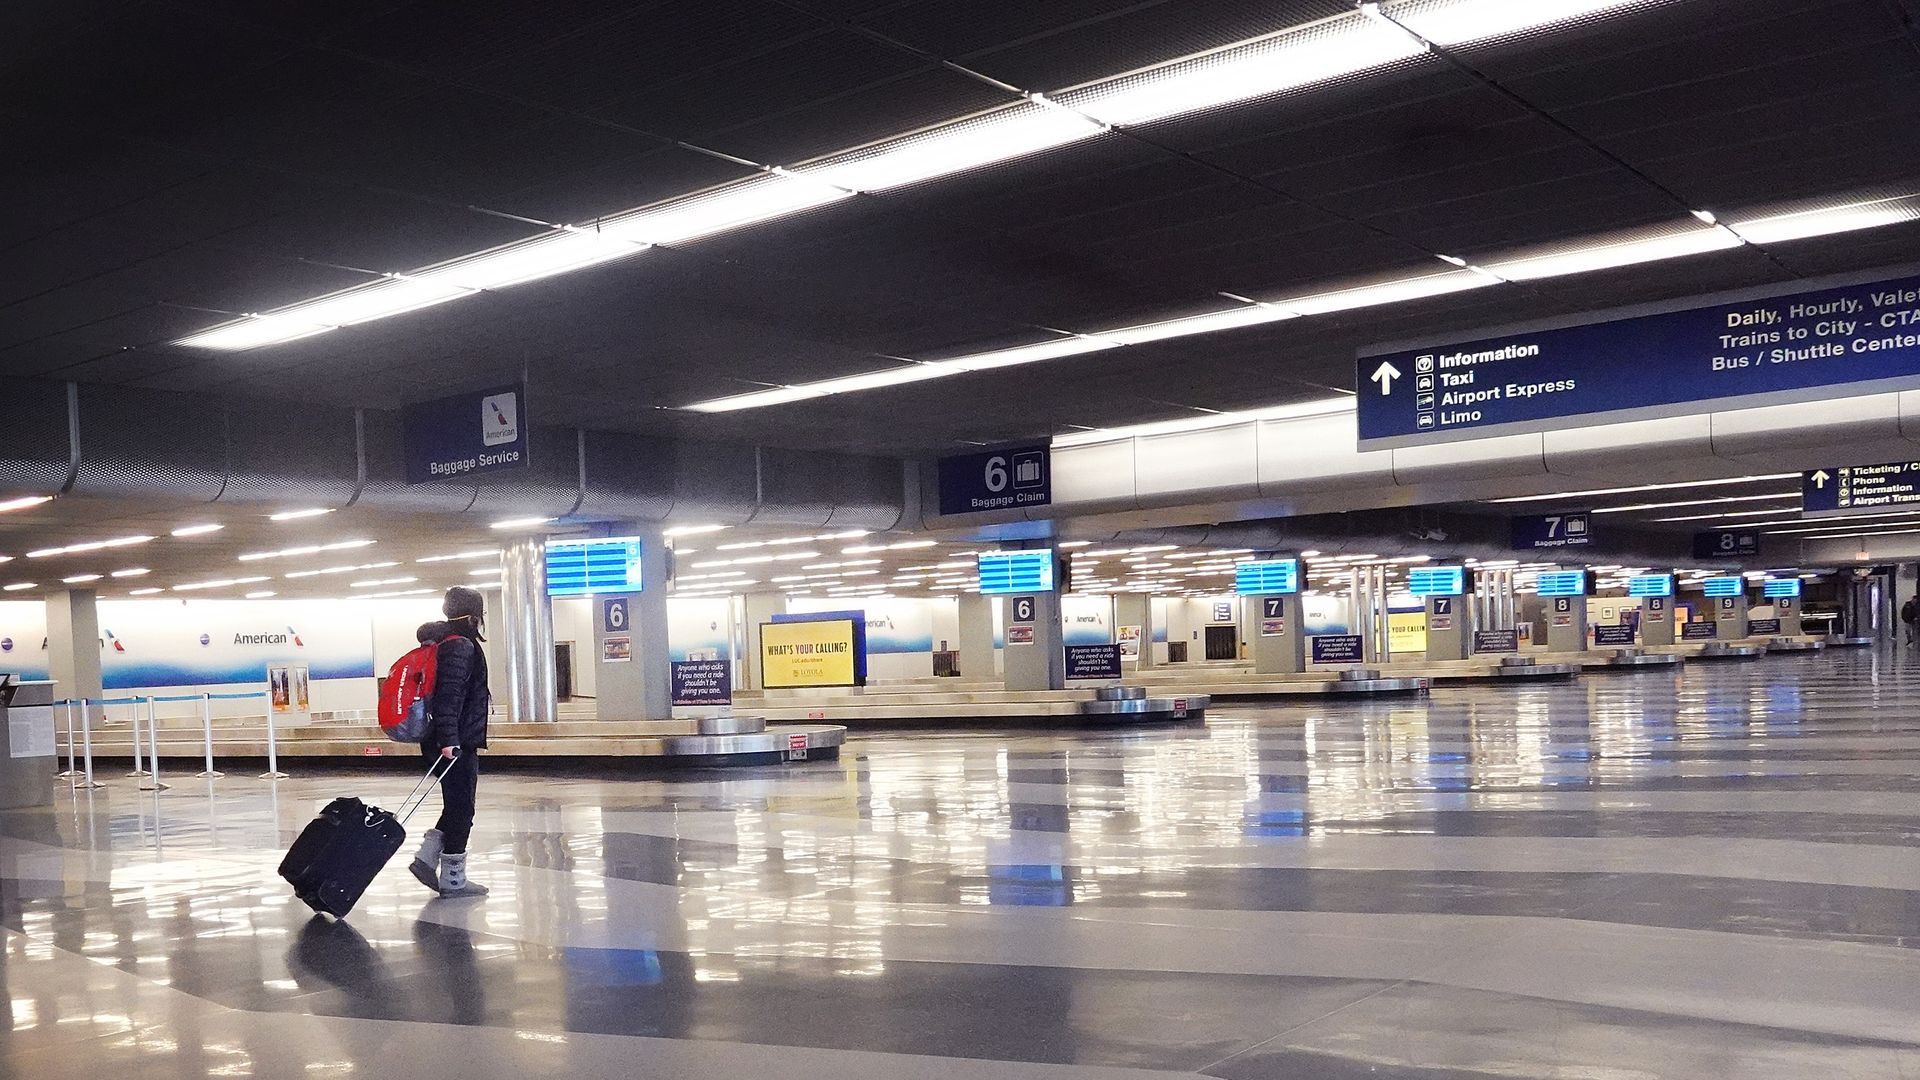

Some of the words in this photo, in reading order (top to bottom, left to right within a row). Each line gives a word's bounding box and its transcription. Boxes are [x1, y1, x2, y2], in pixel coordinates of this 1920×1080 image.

[1727, 309, 1782, 328] Daily,
[1789, 297, 1863, 318] Hourly,
[1719, 331, 1781, 349] Trains
[1787, 326, 1808, 341] to
[1815, 319, 1857, 336] City
[1880, 309, 1920, 328] CTA
[1440, 343, 1539, 368] Information
[1712, 355, 1749, 371] Bus
[1755, 352, 1764, 366] /
[1770, 342, 1845, 364] Shuttle
[1440, 370, 1474, 387] Taxi
[1441, 388, 1501, 408] Airport
[1505, 379, 1576, 400] Express
[1441, 410, 1482, 425] Limo
[485, 427, 515, 439] American
[430, 458, 476, 475] Baggage
[478, 450, 519, 467] Service
[1853, 464, 1901, 475] Ticketing
[985, 456, 1007, 492] 6
[1853, 476, 1886, 486] Phone
[1853, 484, 1913, 496] Information
[971, 495, 1014, 508] Baggage
[1016, 492, 1045, 503] Claim
[1853, 495, 1890, 506] Airport
[1545, 517, 1561, 538] 7
[1720, 533, 1734, 550] 8
[1018, 600, 1030, 619] 6
[1268, 600, 1279, 616] 7
[1437, 599, 1447, 613] 7
[1558, 599, 1567, 611] 8
[1652, 599, 1661, 609] 8
[1724, 598, 1732, 608] 9
[1781, 598, 1788, 608] 9
[610, 603, 624, 628] 6
[233, 632, 287, 645] American
[767, 644, 793, 656] WHAT'S
[795, 643, 814, 655] YOUR
[815, 641, 848, 654] CALLING?
[677, 664, 697, 672] Anyone
[693, 671, 707, 679] need
[680, 688, 697, 697] giving
